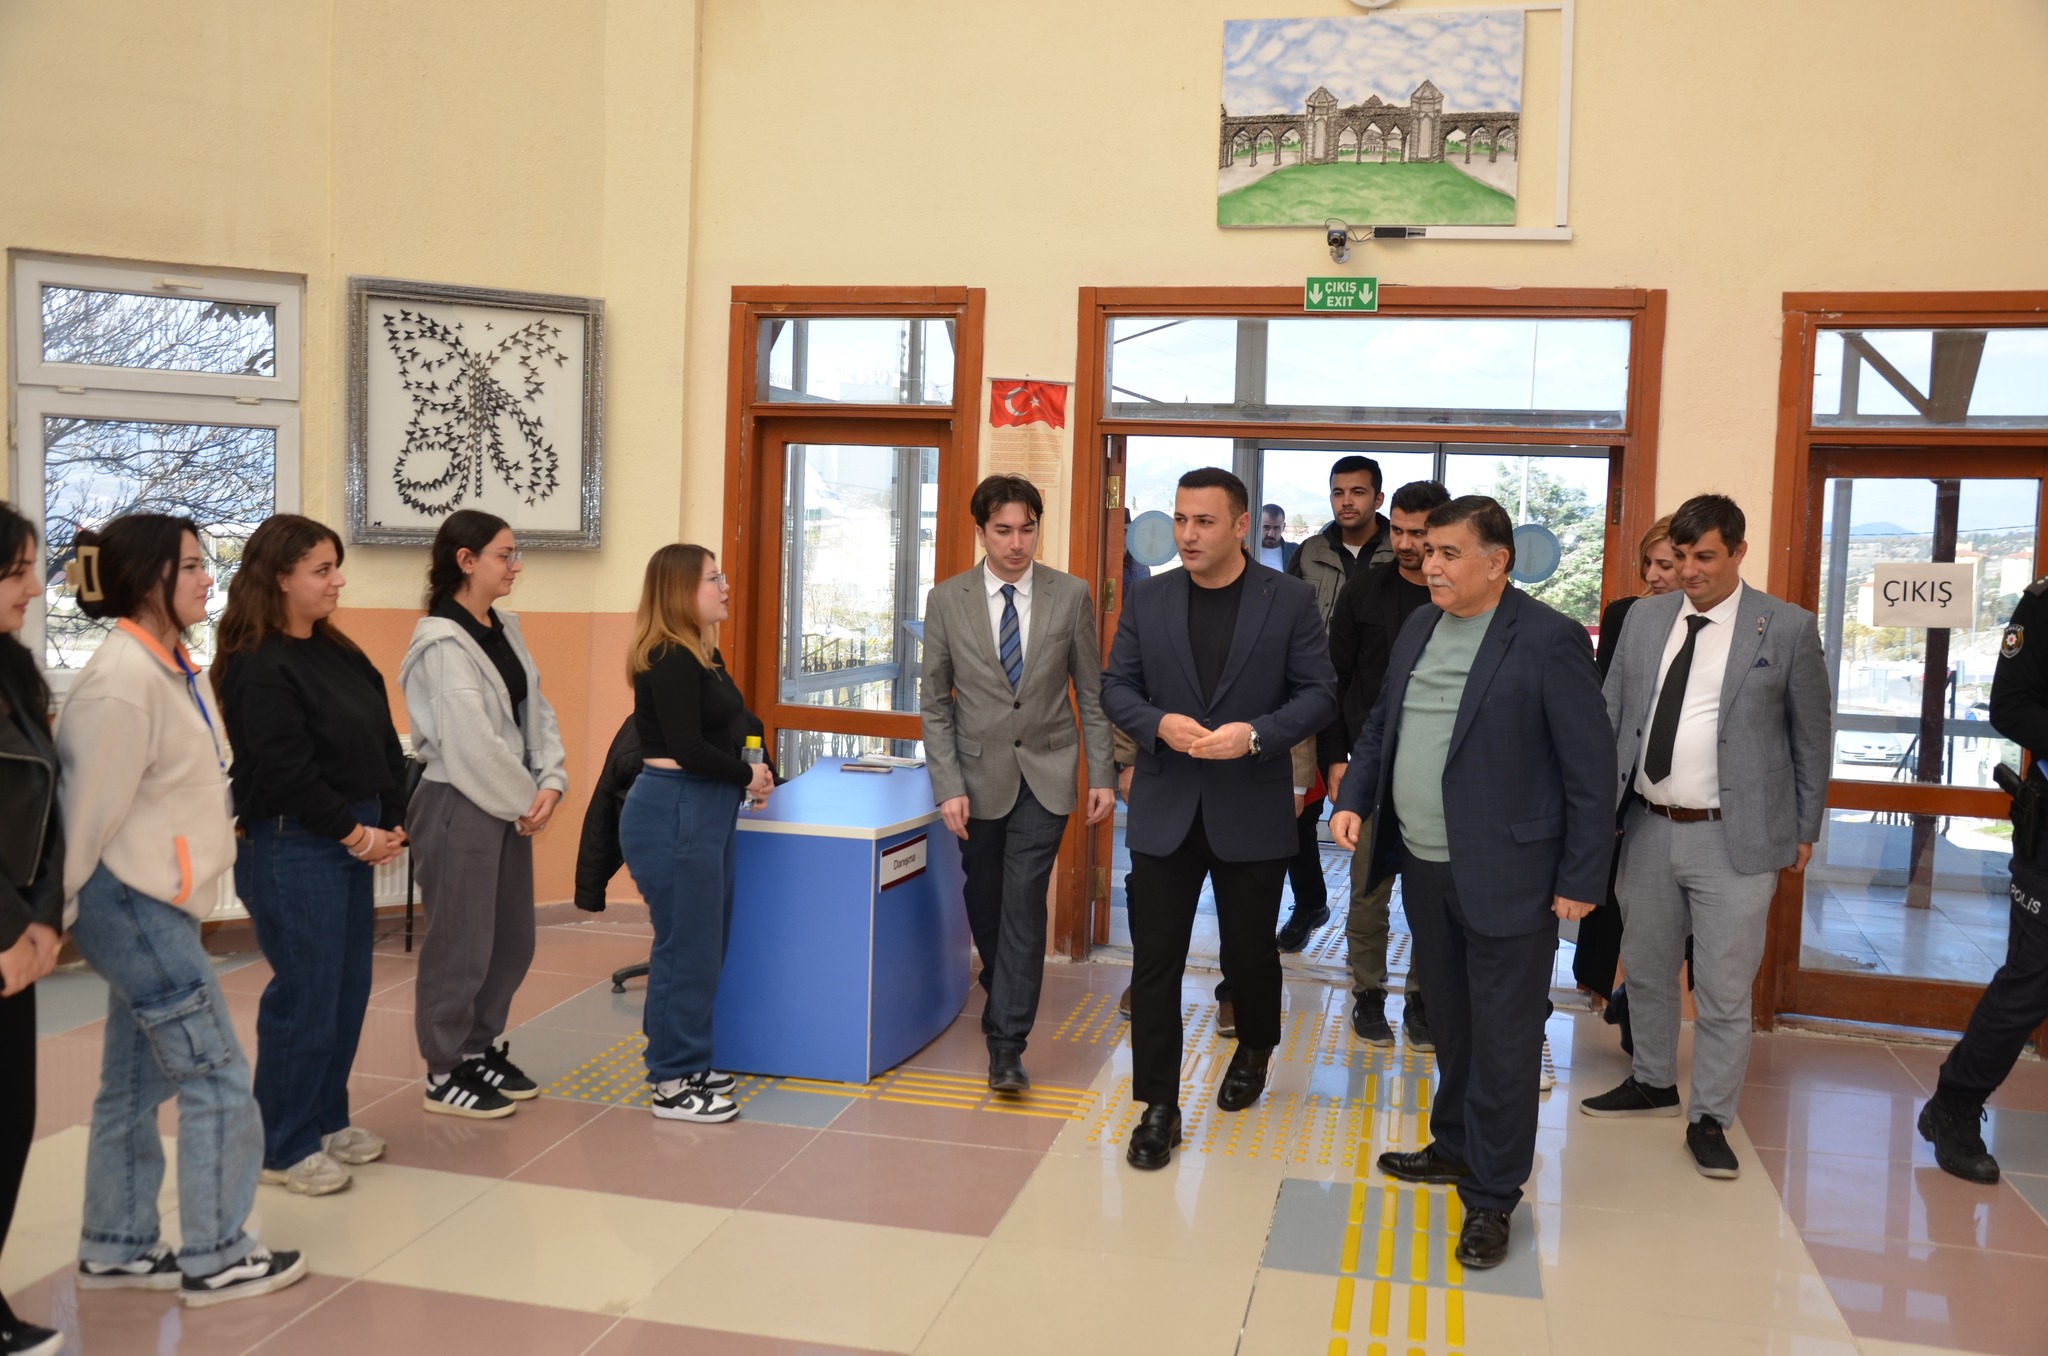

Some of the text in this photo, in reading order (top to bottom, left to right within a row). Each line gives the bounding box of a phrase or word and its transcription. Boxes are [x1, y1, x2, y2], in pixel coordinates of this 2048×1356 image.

[1324, 281, 1357, 294] ÇIKIŞ
[1326, 296, 1354, 307] EXIT
[1883, 580, 1953, 608] ÇIKIŞ
